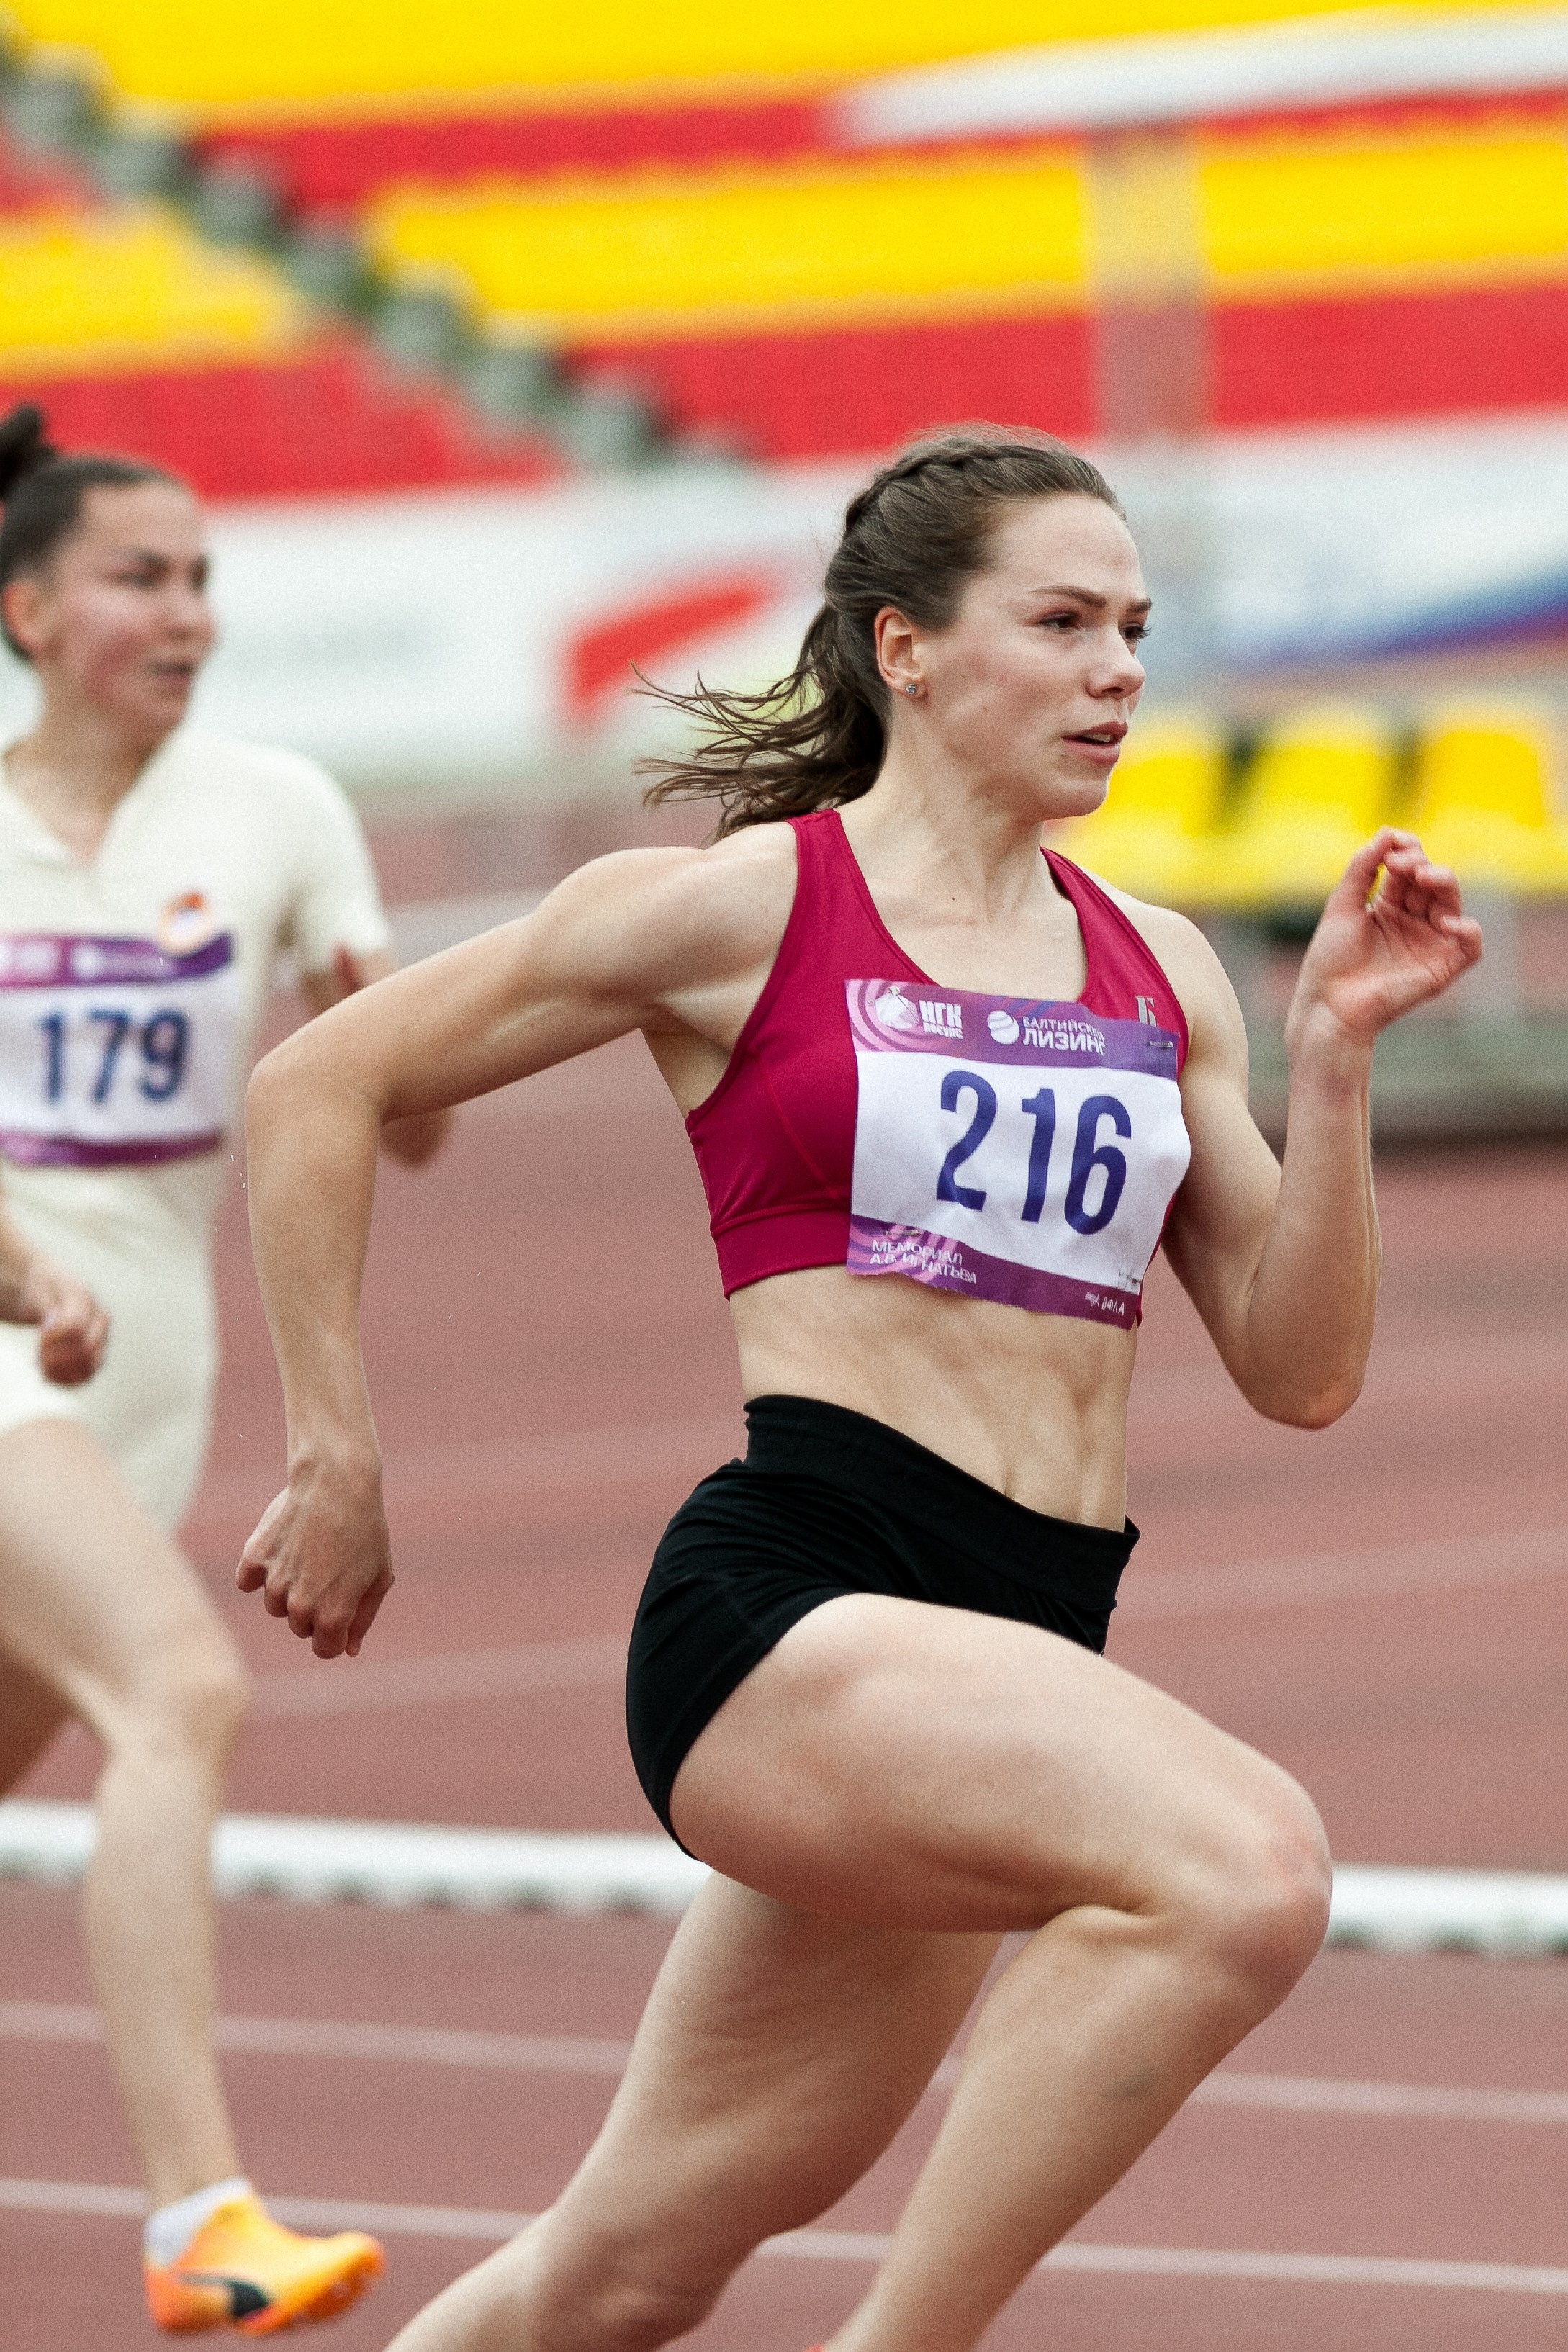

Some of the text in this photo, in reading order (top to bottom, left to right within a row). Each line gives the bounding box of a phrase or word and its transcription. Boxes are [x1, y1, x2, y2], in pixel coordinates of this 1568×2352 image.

[919, 999, 962, 1029] НГК
[39, 1009, 189, 1104] 179
[1022, 1028, 1106, 1056] ЛИЗИНГ
[936, 1070, 1132, 1236] 216
[872, 1240, 963, 1266] МЕМОРИАЛ
